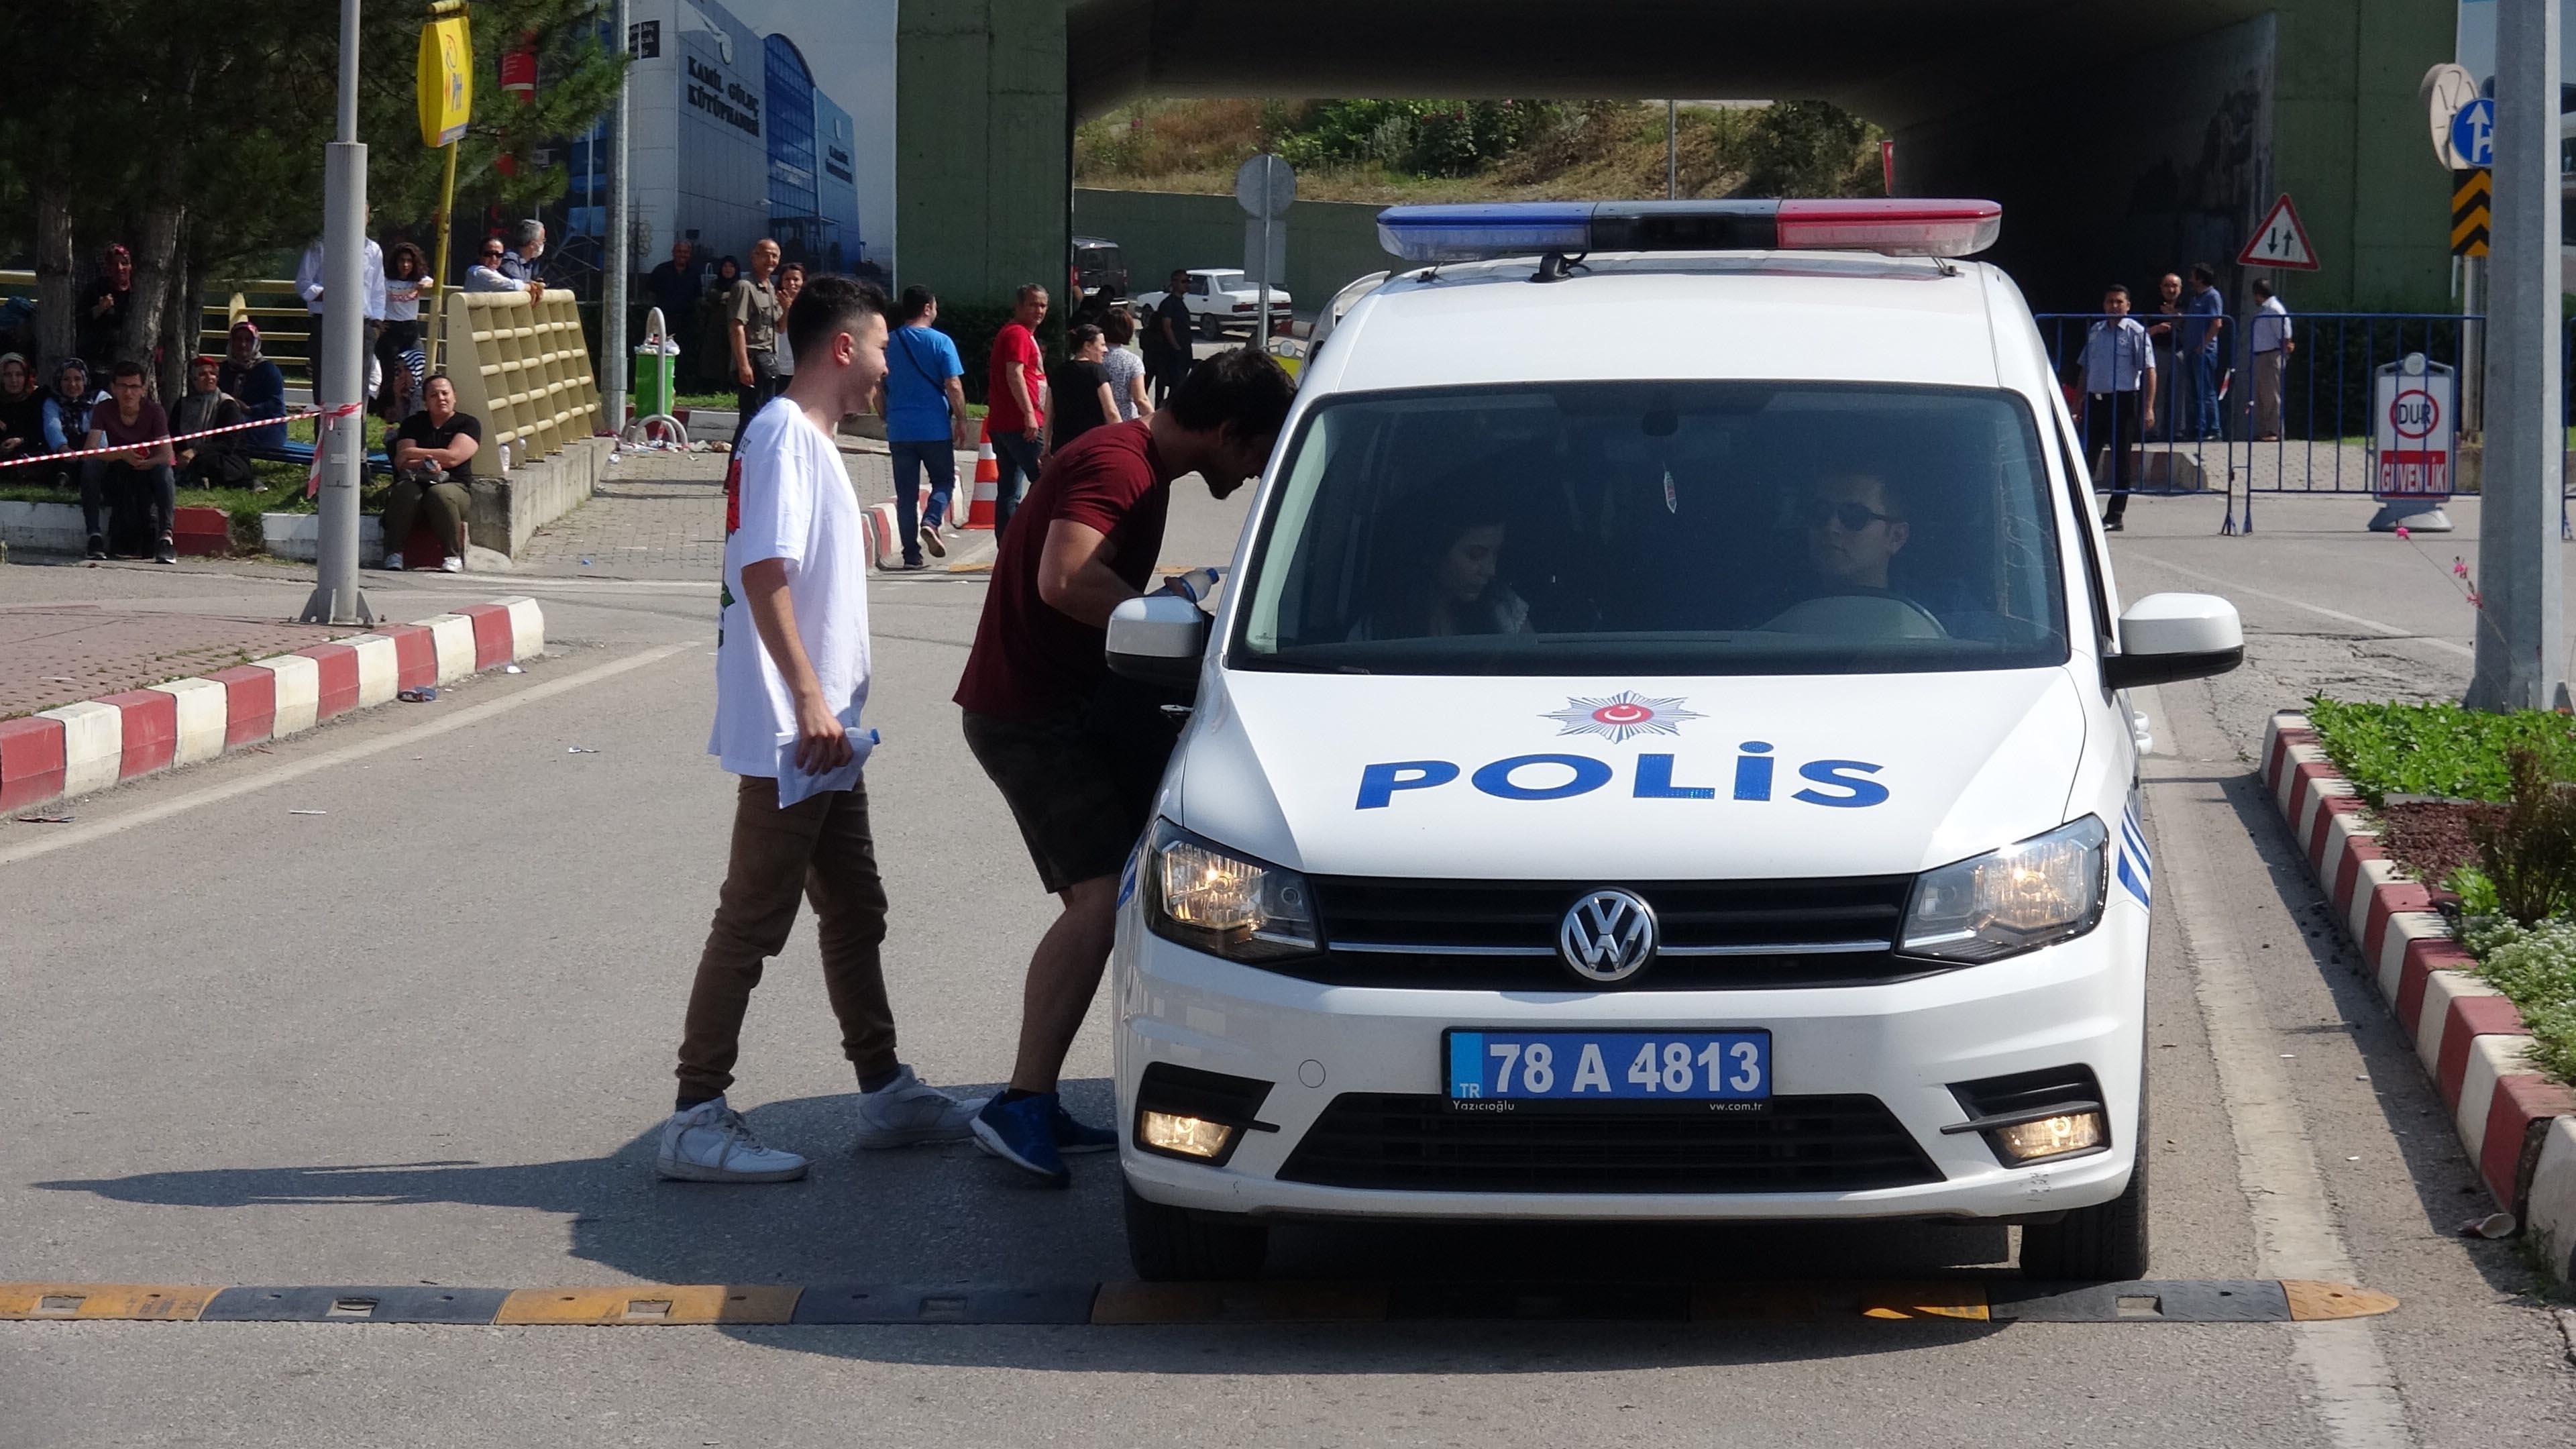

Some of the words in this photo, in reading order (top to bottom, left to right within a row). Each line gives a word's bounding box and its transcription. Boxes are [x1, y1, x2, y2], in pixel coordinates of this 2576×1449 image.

[2398, 404, 2431, 425] DUR
[2381, 456, 2445, 492] GÜVENLİK
[1355, 741, 1890, 810] POLİS
[1490, 1043, 1554, 1093] 78
[1572, 1043, 1611, 1093] A
[1628, 1042, 1760, 1093] 4813
[1459, 1083, 1481, 1098] TR
[1709, 1102, 1763, 1111] vw.com.tr
